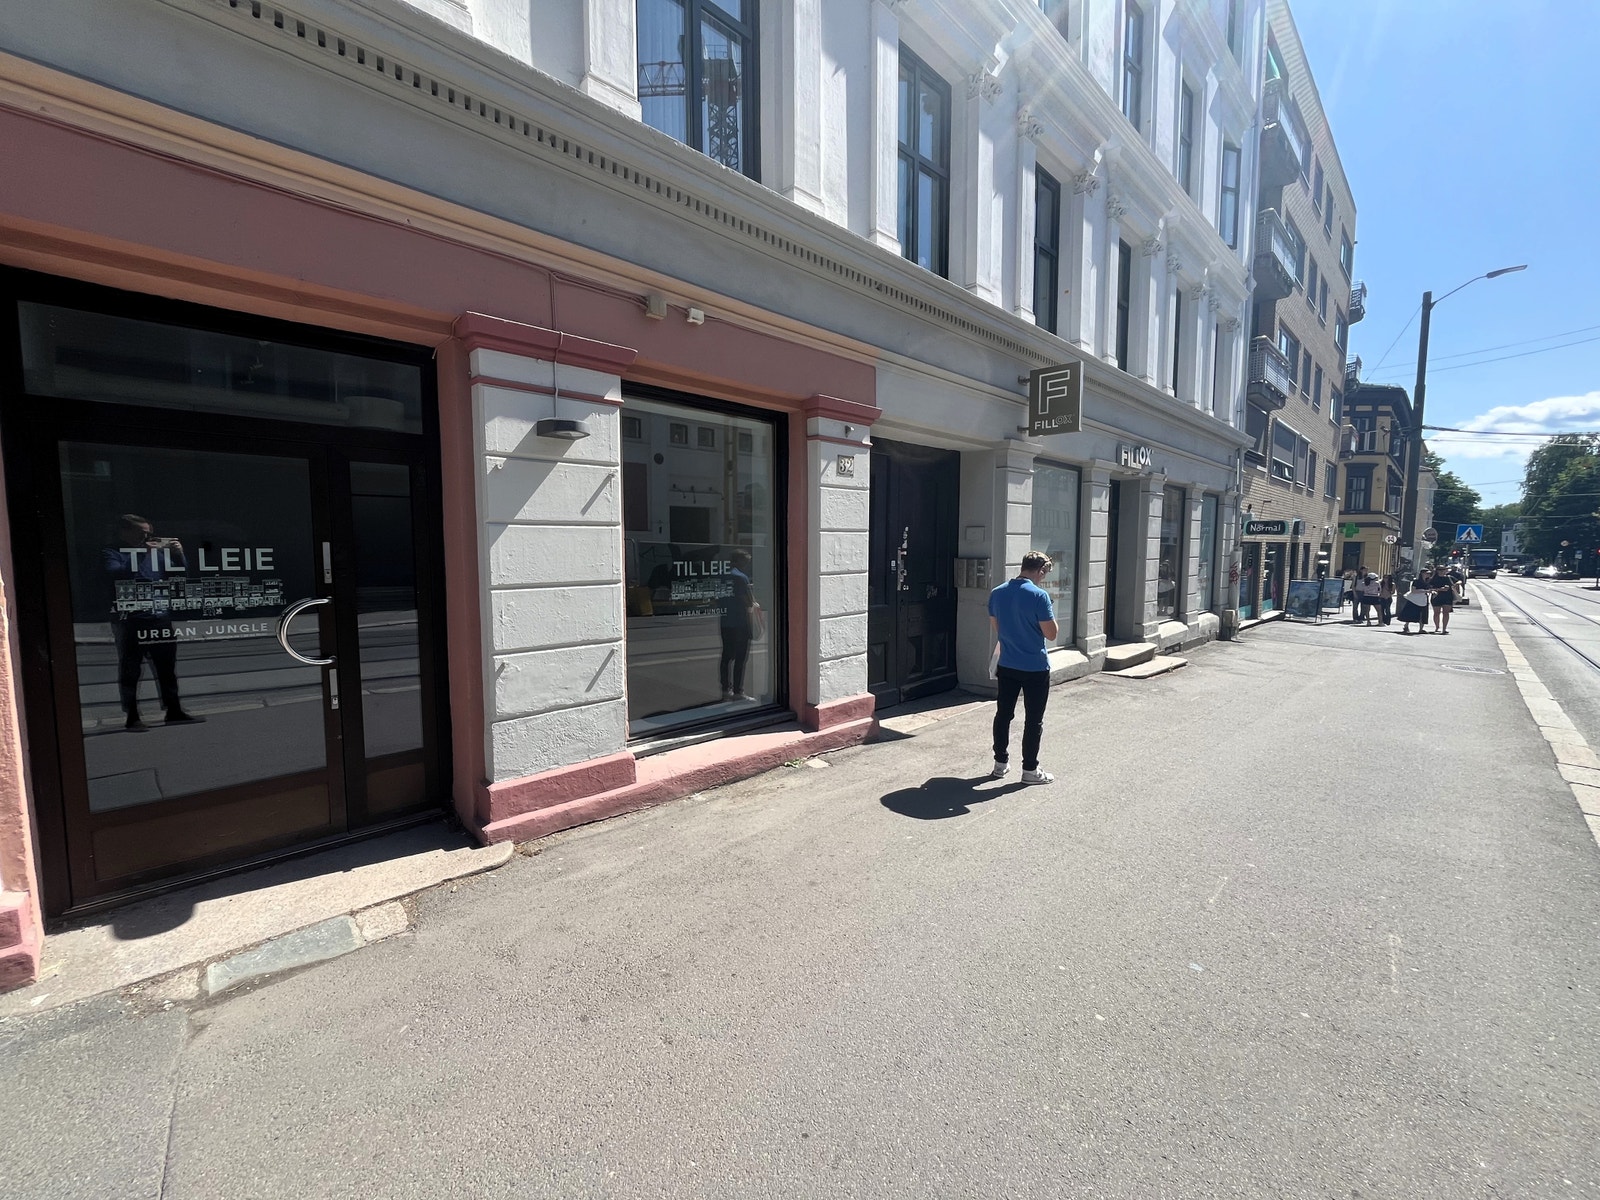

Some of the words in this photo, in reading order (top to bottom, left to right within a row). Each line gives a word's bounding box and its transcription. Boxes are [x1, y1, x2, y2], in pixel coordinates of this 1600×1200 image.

[1038, 369, 1071, 415] F
[1034, 414, 1073, 430] FILLOX
[839, 457, 854, 473] 32
[1121, 446, 1152, 470] FILLOX
[1250, 523, 1281, 531] Normal
[119, 547, 186, 572] TIL
[198, 547, 275, 571] LEIE
[673, 561, 698, 576] TIL
[702, 560, 731, 576] LEIE
[137, 627, 197, 640] URBAN
[205, 622, 269, 635] JUNGLE
